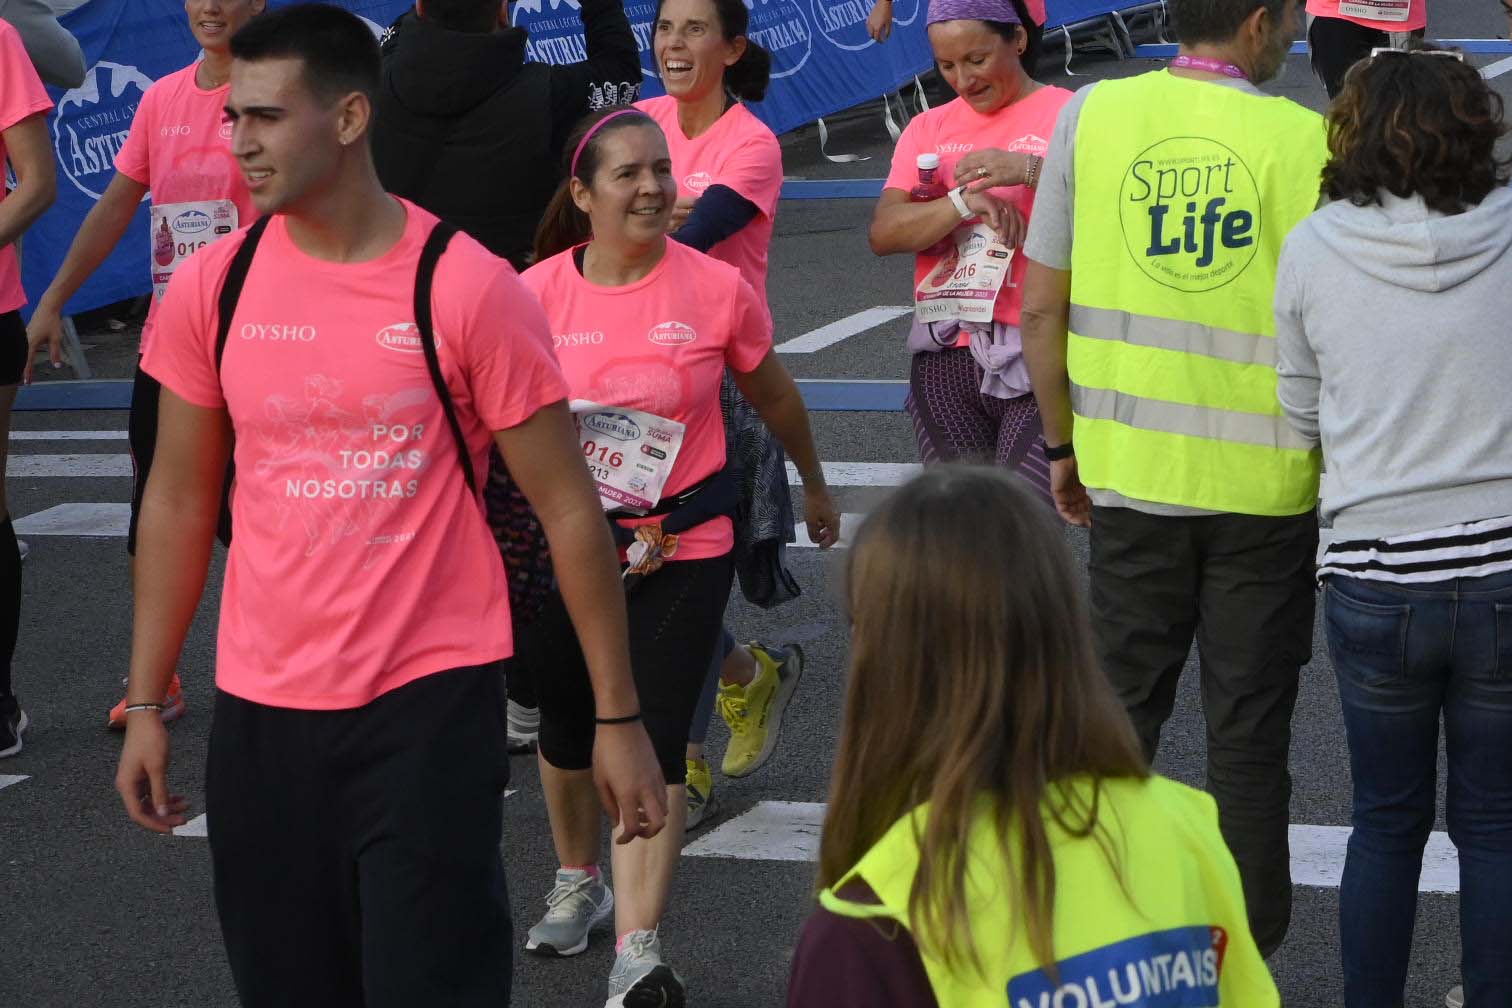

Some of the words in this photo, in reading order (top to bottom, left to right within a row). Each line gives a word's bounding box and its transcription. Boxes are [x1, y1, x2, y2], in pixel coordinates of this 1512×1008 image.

[1129, 156, 1236, 207] Sport
[1145, 196, 1254, 268] Life
[953, 263, 977, 280] 016
[240, 323, 317, 342] OYSHO
[372, 424, 425, 442] POR
[587, 415, 637, 439] ASTURIANA
[339, 450, 424, 470] TODAS
[583, 440, 624, 468] 016
[285, 478, 418, 499] NOSOTRAS
[623, 494, 643, 507] 2023
